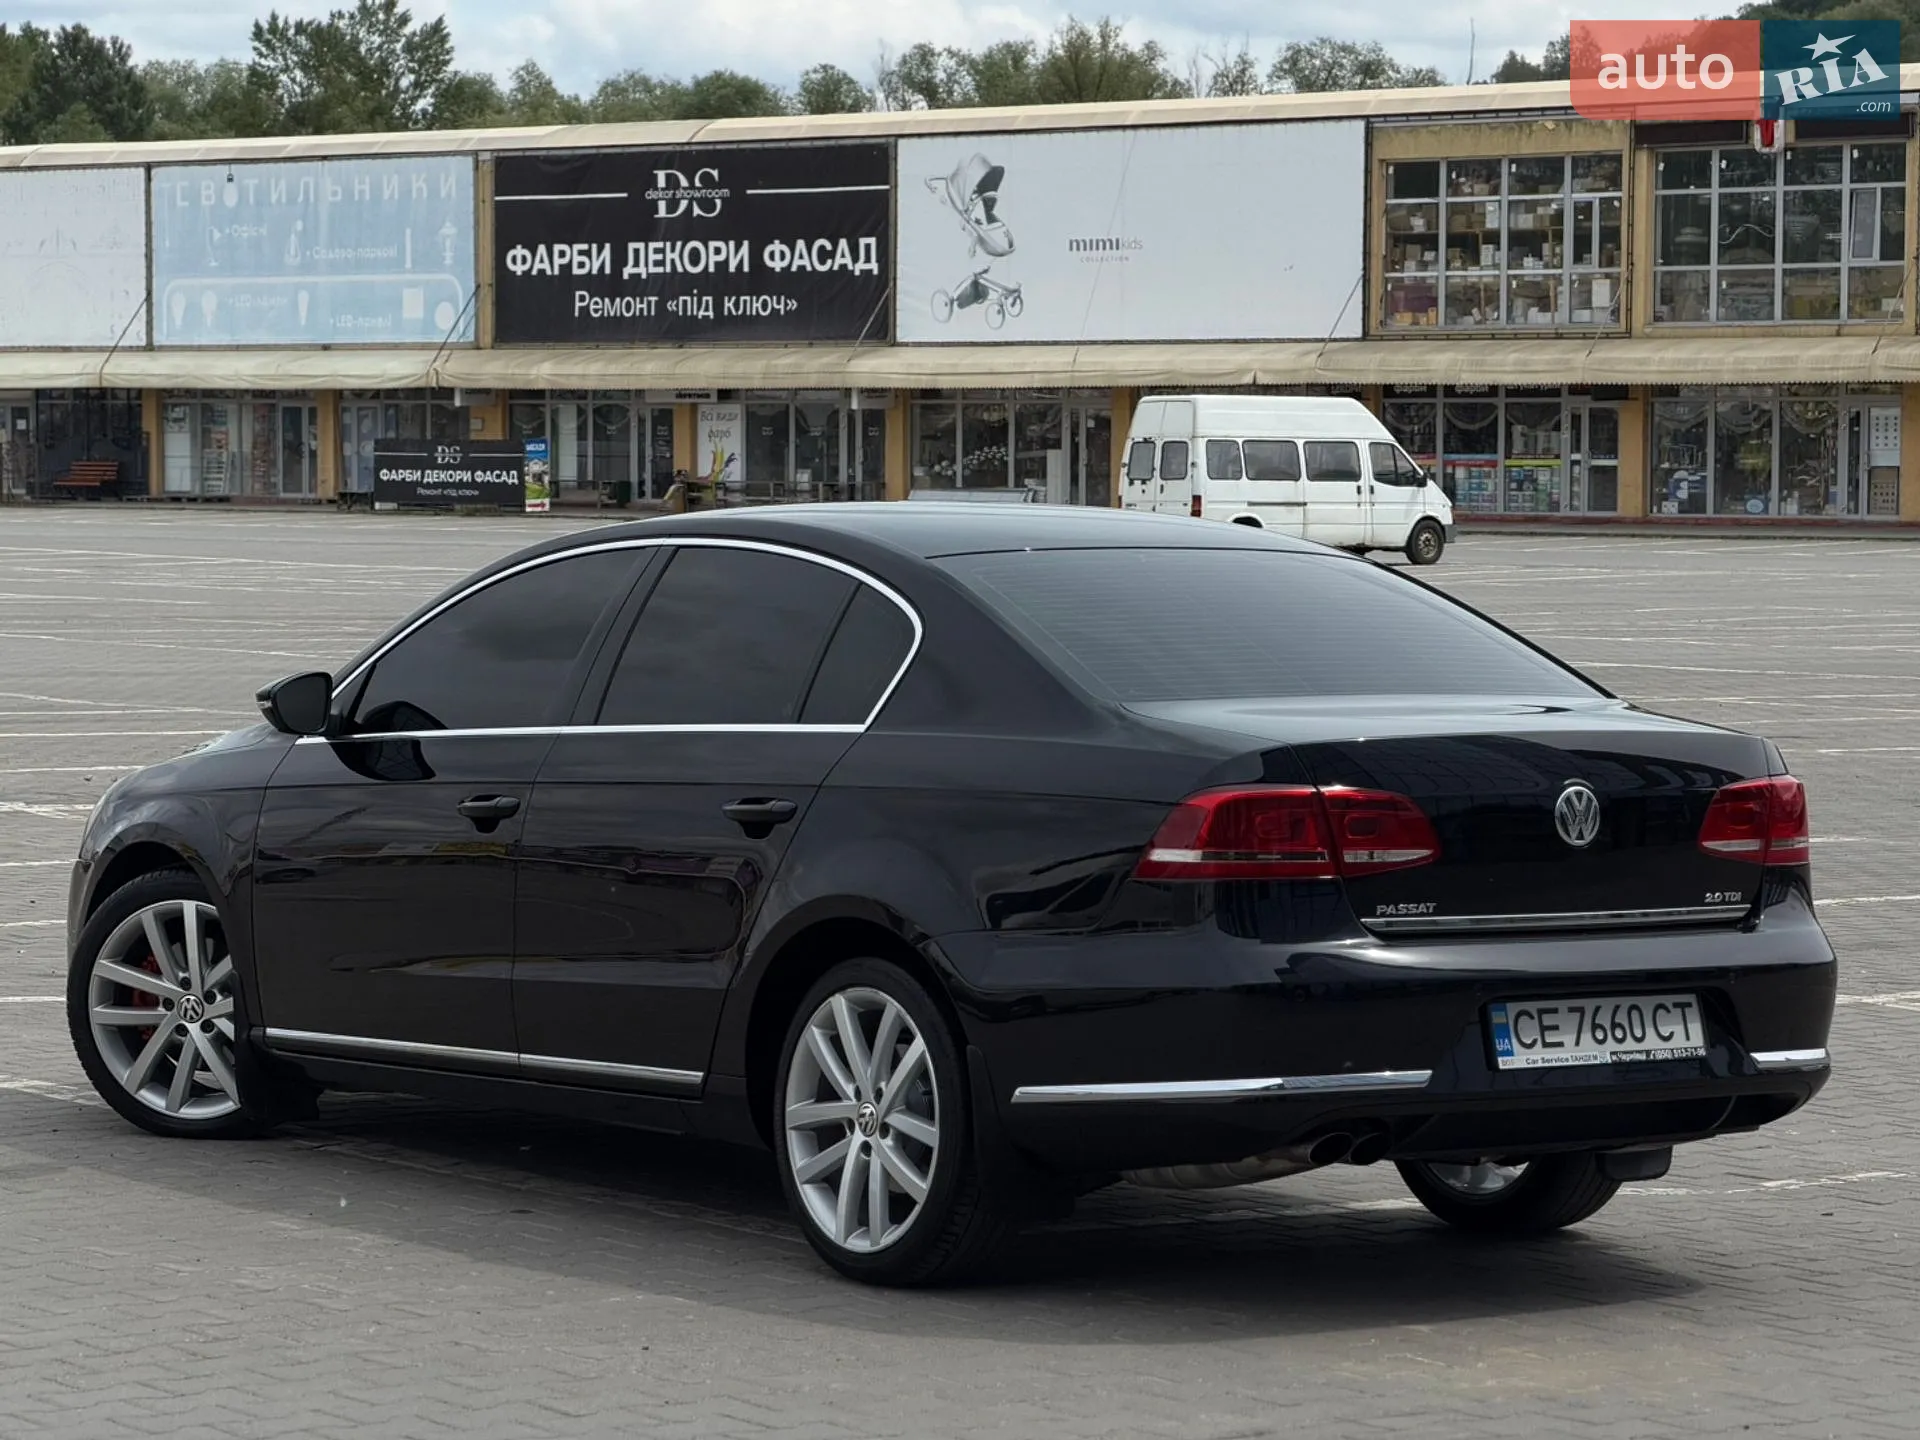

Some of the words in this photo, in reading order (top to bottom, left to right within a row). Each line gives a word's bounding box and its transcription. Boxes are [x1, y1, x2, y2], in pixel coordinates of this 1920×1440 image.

[645, 188, 674, 199] dekor
[675, 187, 730, 198] showroom
[653, 167, 722, 218] DS
[506, 244, 611, 276] ФАРБИ
[623, 240, 749, 279] ДЕКОРИ
[763, 237, 878, 275] ФАСАД
[574, 290, 658, 317] Ремонт
[667, 289, 714, 319] «під
[724, 293, 798, 316] ключ»
[379, 469, 421, 482] ФАРБИ
[423, 470, 472, 483] ДЕКОРИ
[474, 470, 519, 485] ФАСАД
[1723, 891, 1742, 902] TDI
[1375, 902, 1438, 916] PASSAT
[1541, 1055, 1569, 1064] Service
